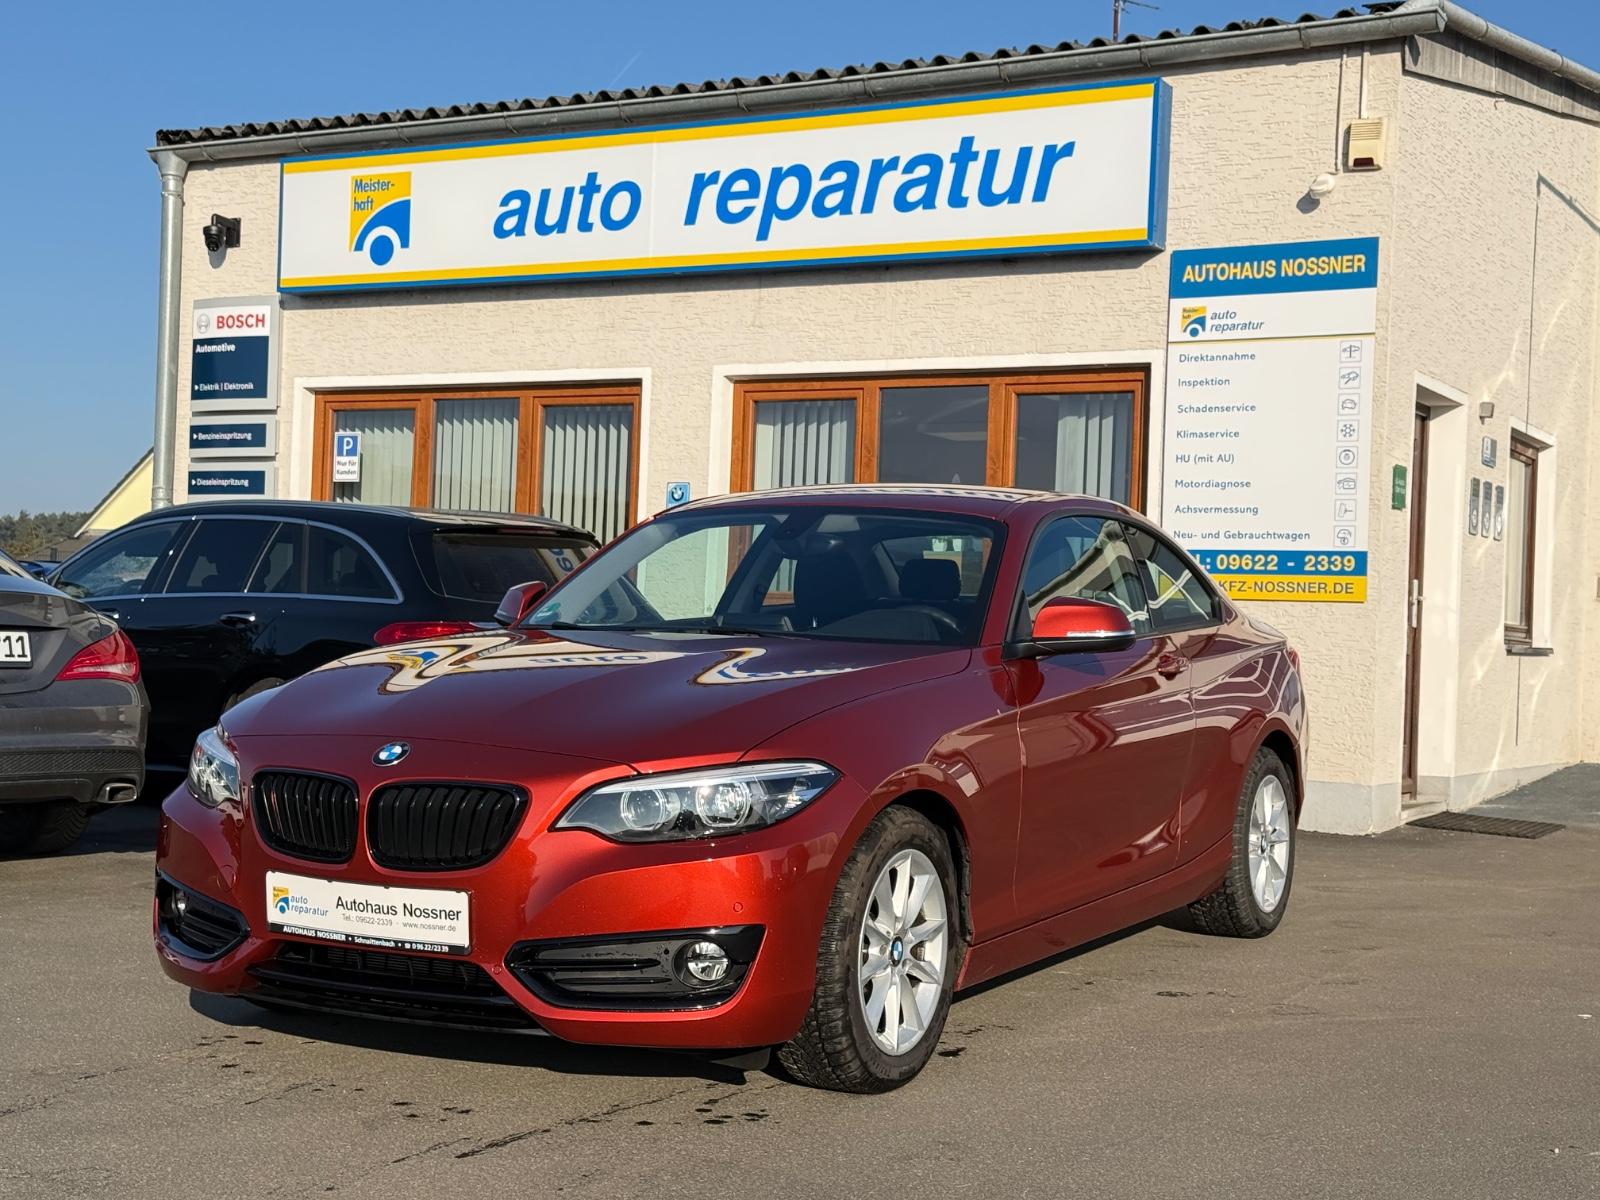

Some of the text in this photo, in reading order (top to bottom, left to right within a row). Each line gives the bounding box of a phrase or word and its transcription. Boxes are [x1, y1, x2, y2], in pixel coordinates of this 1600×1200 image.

[353, 178, 395, 193] Meister-
[493, 135, 1076, 242] auto reparatur
[353, 196, 374, 211] haft
[1183, 254, 1366, 283] AUTOHAUS NOSSNER
[216, 313, 266, 329] BOSCH
[1210, 310, 1237, 320] auto
[1210, 321, 1264, 333] reparatur
[195, 343, 236, 353] Automotive
[1179, 351, 1256, 363] Direktannahme
[199, 382, 220, 391] Elektrik
[224, 382, 254, 391] Elektronik
[1178, 377, 1230, 389] Inspektion
[1178, 402, 1257, 414] Schadenservice
[198, 432, 252, 441] Benzineinspritzung
[1176, 429, 1240, 439] Klimaservice
[343, 437, 353, 456] P
[1175, 454, 1235, 465] HU (mit AU)
[196, 478, 249, 487] Dieseleinspritzung
[1174, 479, 1252, 491] Motordiagnose
[1174, 504, 1259, 516] Achsvermessung
[1173, 530, 1311, 542] Neu- und Gebrauchtwagen
[1216, 553, 1279, 571] 09622
[1303, 554, 1356, 572] 2339
[1219, 580, 1355, 595] KFZ-NOSSNER.DE
[0, 635, 28, 658] 11
[290, 896, 308, 905] auto
[290, 905, 329, 917] reparatur
[335, 896, 462, 921] Autohaus Nossner
[355, 915, 393, 927] 09622-2339
[402, 922, 457, 932] www.nossner.de
[283, 926, 316, 937] AUTOHAUS
[316, 930, 346, 942] NOSSNER
